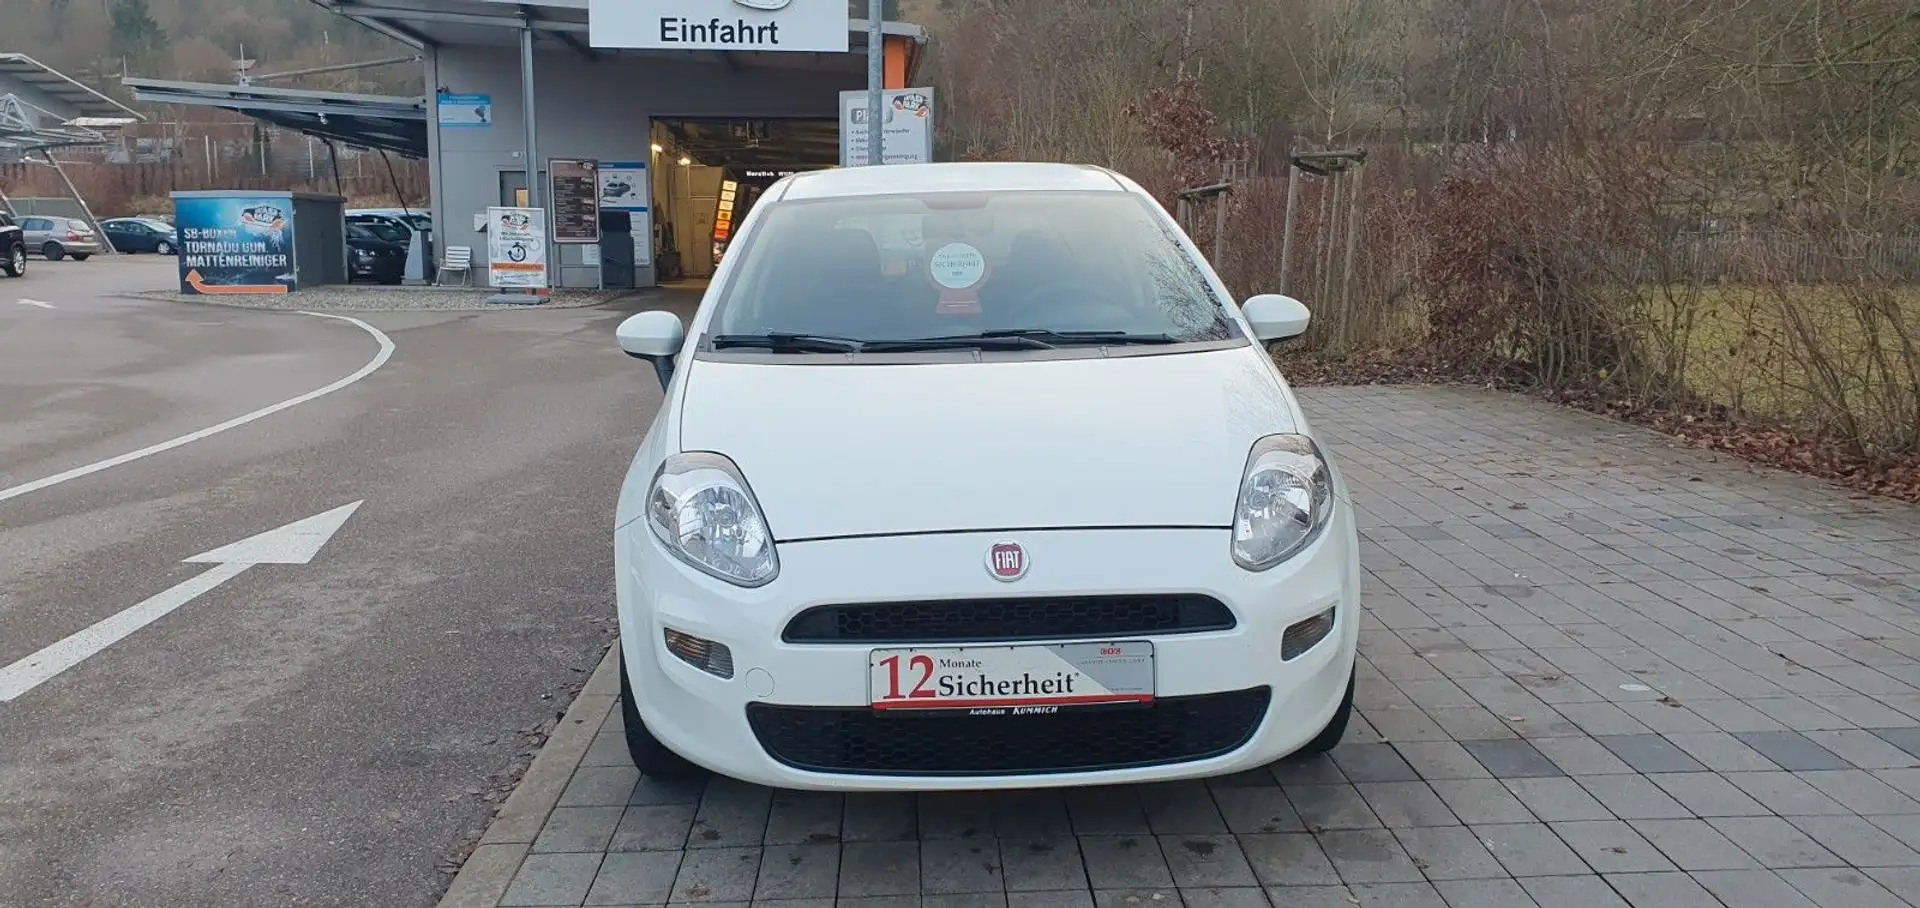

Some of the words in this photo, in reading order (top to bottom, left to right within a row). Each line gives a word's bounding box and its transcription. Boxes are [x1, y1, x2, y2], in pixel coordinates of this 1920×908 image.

[660, 17, 778, 45] Einfahrt
[184, 241, 239, 253] TORNADO
[186, 254, 287, 267] MATTENREINIGER
[995, 550, 1019, 569] FIAT
[879, 654, 936, 699] 12
[939, 658, 982, 668] Monate
